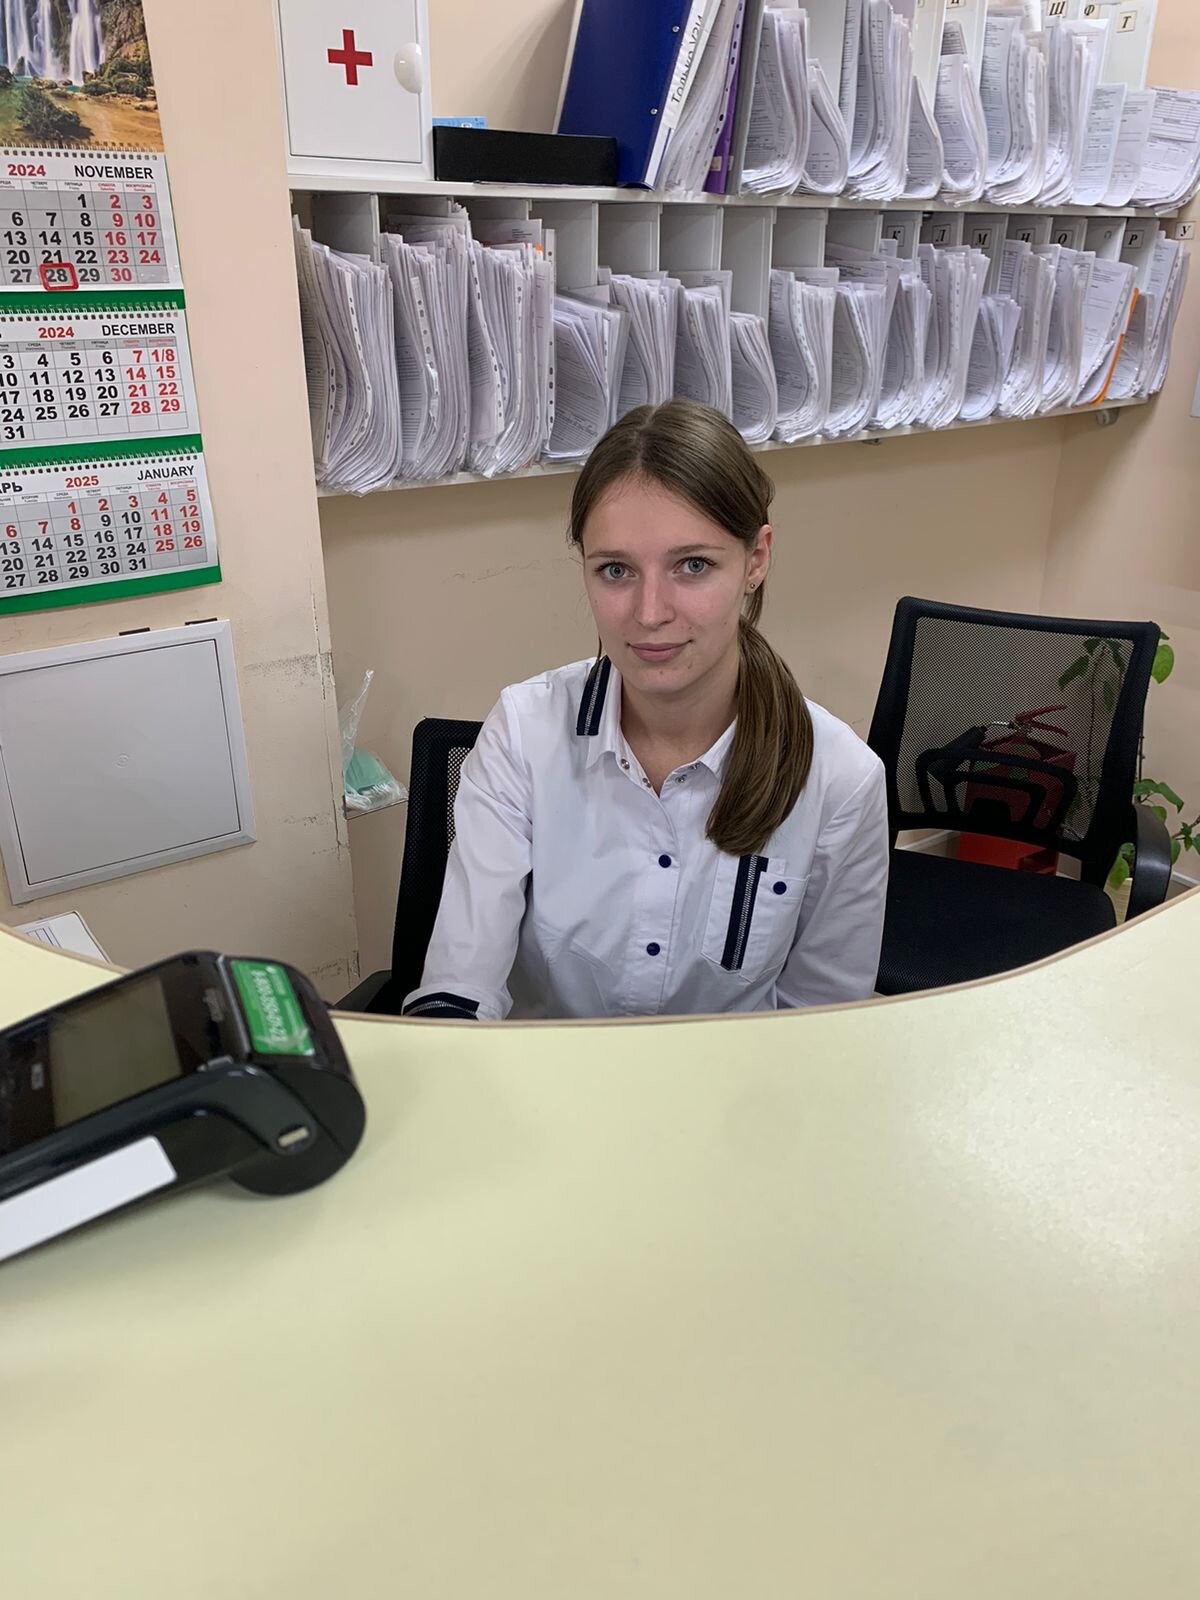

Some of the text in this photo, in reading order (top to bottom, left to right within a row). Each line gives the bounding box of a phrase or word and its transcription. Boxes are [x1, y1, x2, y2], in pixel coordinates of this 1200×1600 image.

[1049, 1, 1066, 16] Ш
[1083, 4, 1095, 17] Ф
[8, 164, 154, 179] 2024 NOVEMBER
[78, 194, 152, 209] 1 2 3
[12, 212, 155, 227] 6 7 8 9 10
[4, 231, 157, 246] 13 14 15 16 17
[935, 229, 946, 242] Л
[1180, 225, 1191, 237] У
[975, 233, 988, 246] М
[1128, 234, 1138, 245] Р
[7, 250, 160, 264] 20 21 22 23 24
[10, 268, 132, 282] 27 28 29 30
[39, 323, 175, 338] 2024 DECEMBER
[2, 355, 14, 369] 3
[38, 354, 48, 367] 4
[70, 353, 81, 365] 5
[102, 351, 112, 364] 6
[133, 350, 142, 363] 7
[30, 372, 50, 385] 11
[63, 370, 84, 383] 12
[94, 369, 115, 381] 13
[126, 368, 146, 380] 14
[156, 366, 175, 378] 15
[0, 383, 177, 404] 17 18 19 20 21 22
[2, 399, 180, 422] 24 25 26 27 28 29
[4, 426, 25, 439] 31
[65, 475, 99, 488] 2025
[137, 466, 195, 481] JANUARY
[68, 489, 196, 514] 1 2 3 4 5
[6, 505, 198, 537] 6 7 8 9 10 11 12
[0, 520, 200, 554] 13 14 15 16 17 18 19
[2, 536, 202, 572] 20 21 22 23 24 25 26
[5, 558, 147, 588] 27 28 29 30 31
